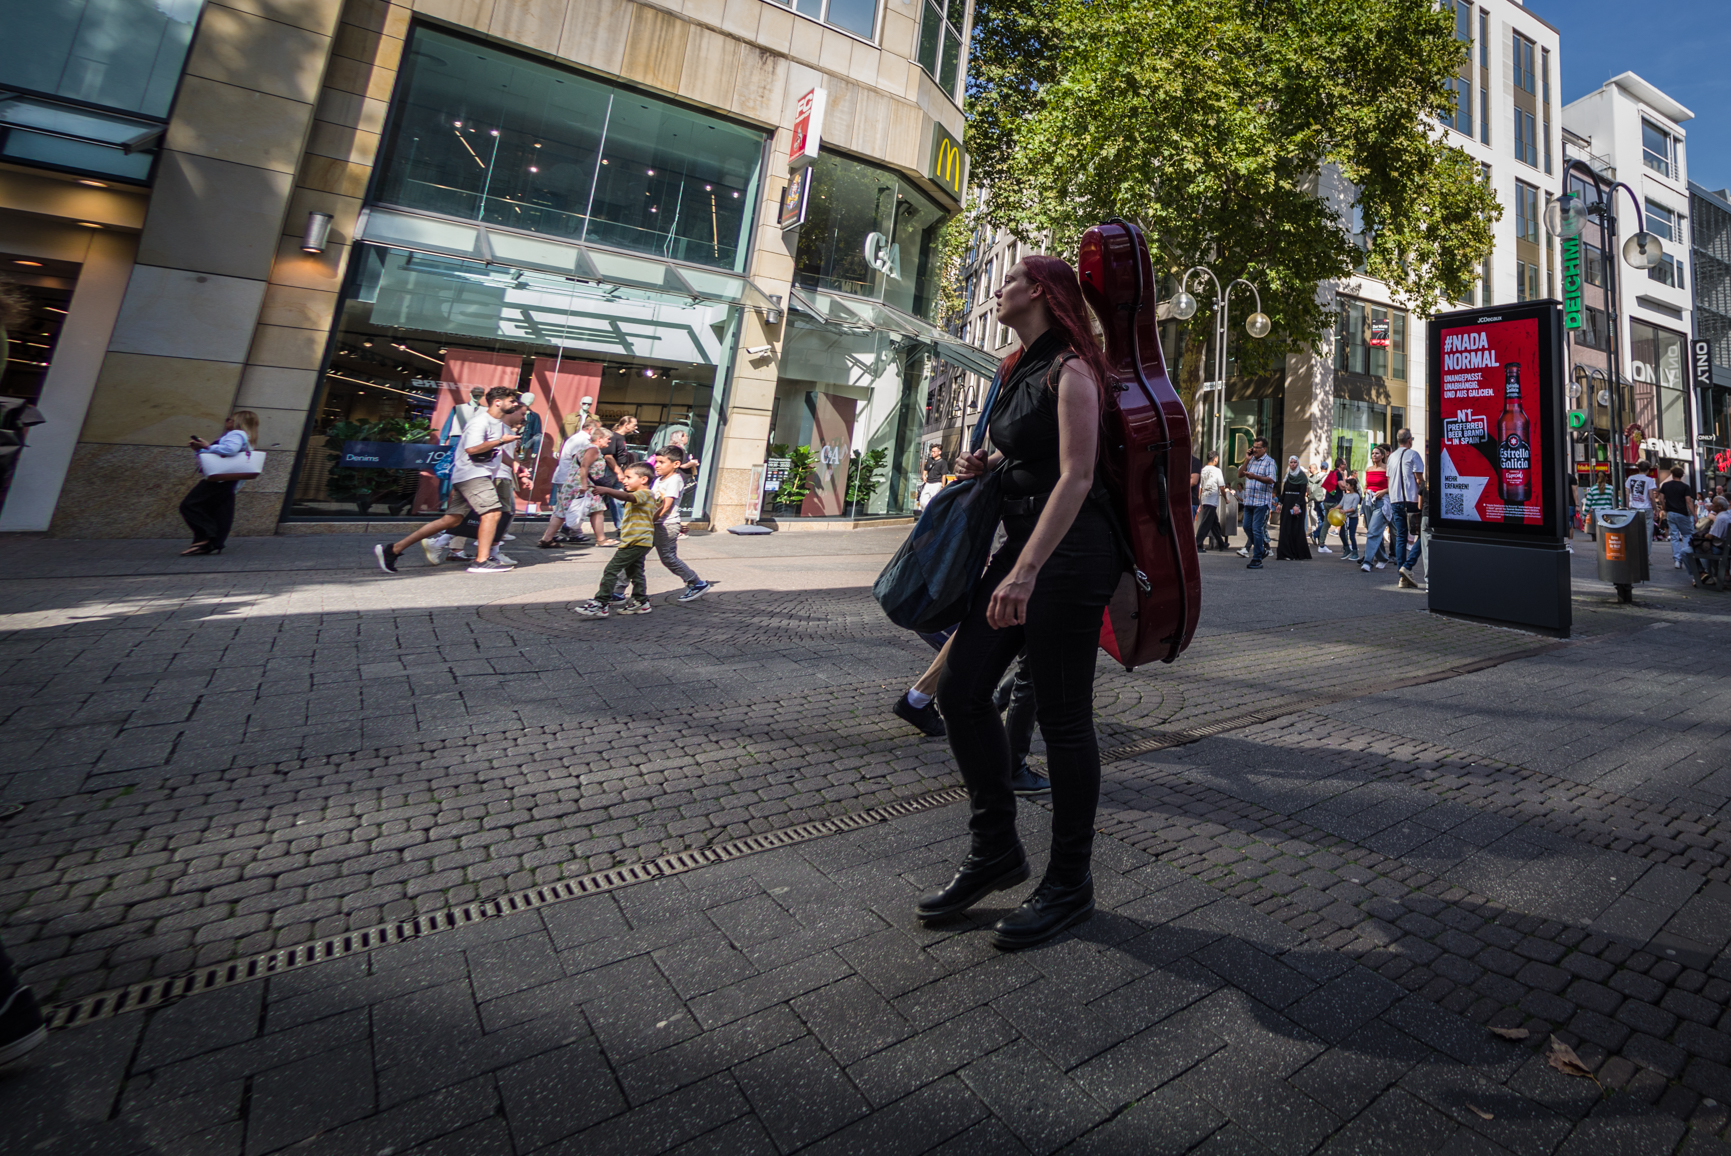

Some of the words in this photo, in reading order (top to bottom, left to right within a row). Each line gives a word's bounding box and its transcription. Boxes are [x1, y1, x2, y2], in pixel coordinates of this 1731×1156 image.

[797, 93, 813, 118] FC
[865, 231, 902, 281] C&A
[1444, 332, 1488, 352] #NADA
[1444, 350, 1500, 371] NORMAL
[1695, 342, 1710, 384] ONLY
[1444, 373, 1483, 382] UNANGEPASST.
[1631, 360, 1676, 388] ONLY
[1444, 381, 1479, 390] UNABHÄNGIG.
[1468, 388, 1494, 397] GALICIEN.
[597, 408, 630, 419] omen
[1570, 412, 1585, 428] D
[1447, 421, 1483, 432] PREFERRED
[1448, 431, 1462, 439] BEER
[1463, 429, 1484, 437] BRAND
[1460, 436, 1480, 445] SPAIN
[1648, 438, 1684, 457] ONLY
[346, 453, 379, 462] Denims
[425, 451, 446, 464] 19
[1499, 448, 1529, 459] Estrella
[1500, 459, 1529, 469] Galicia
